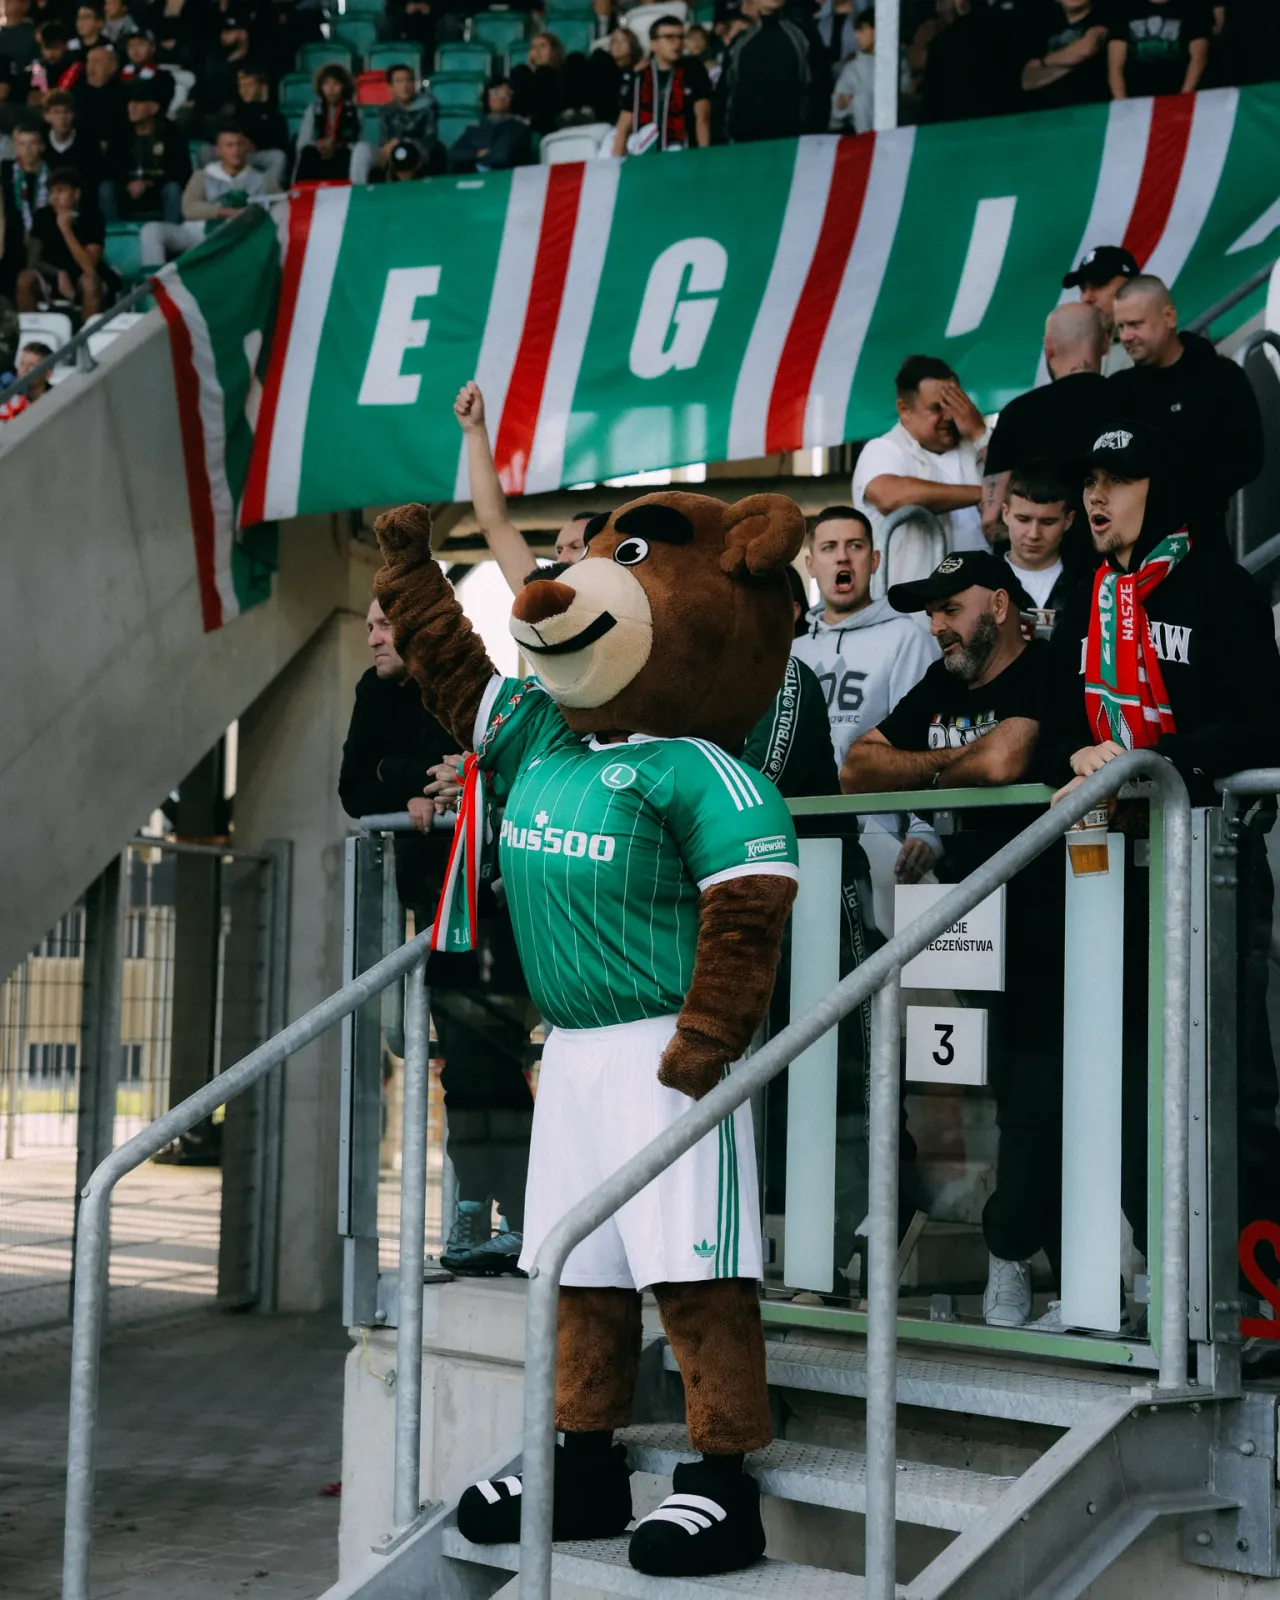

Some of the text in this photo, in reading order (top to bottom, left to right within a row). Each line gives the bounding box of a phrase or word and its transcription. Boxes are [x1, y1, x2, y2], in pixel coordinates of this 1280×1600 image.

[1119, 584, 1134, 641] NASZE
[829, 714, 861, 724] OWIEC
[499, 819, 616, 862] Plus500
[748, 839, 787, 858] Królewskie
[932, 1023, 955, 1066] 3
